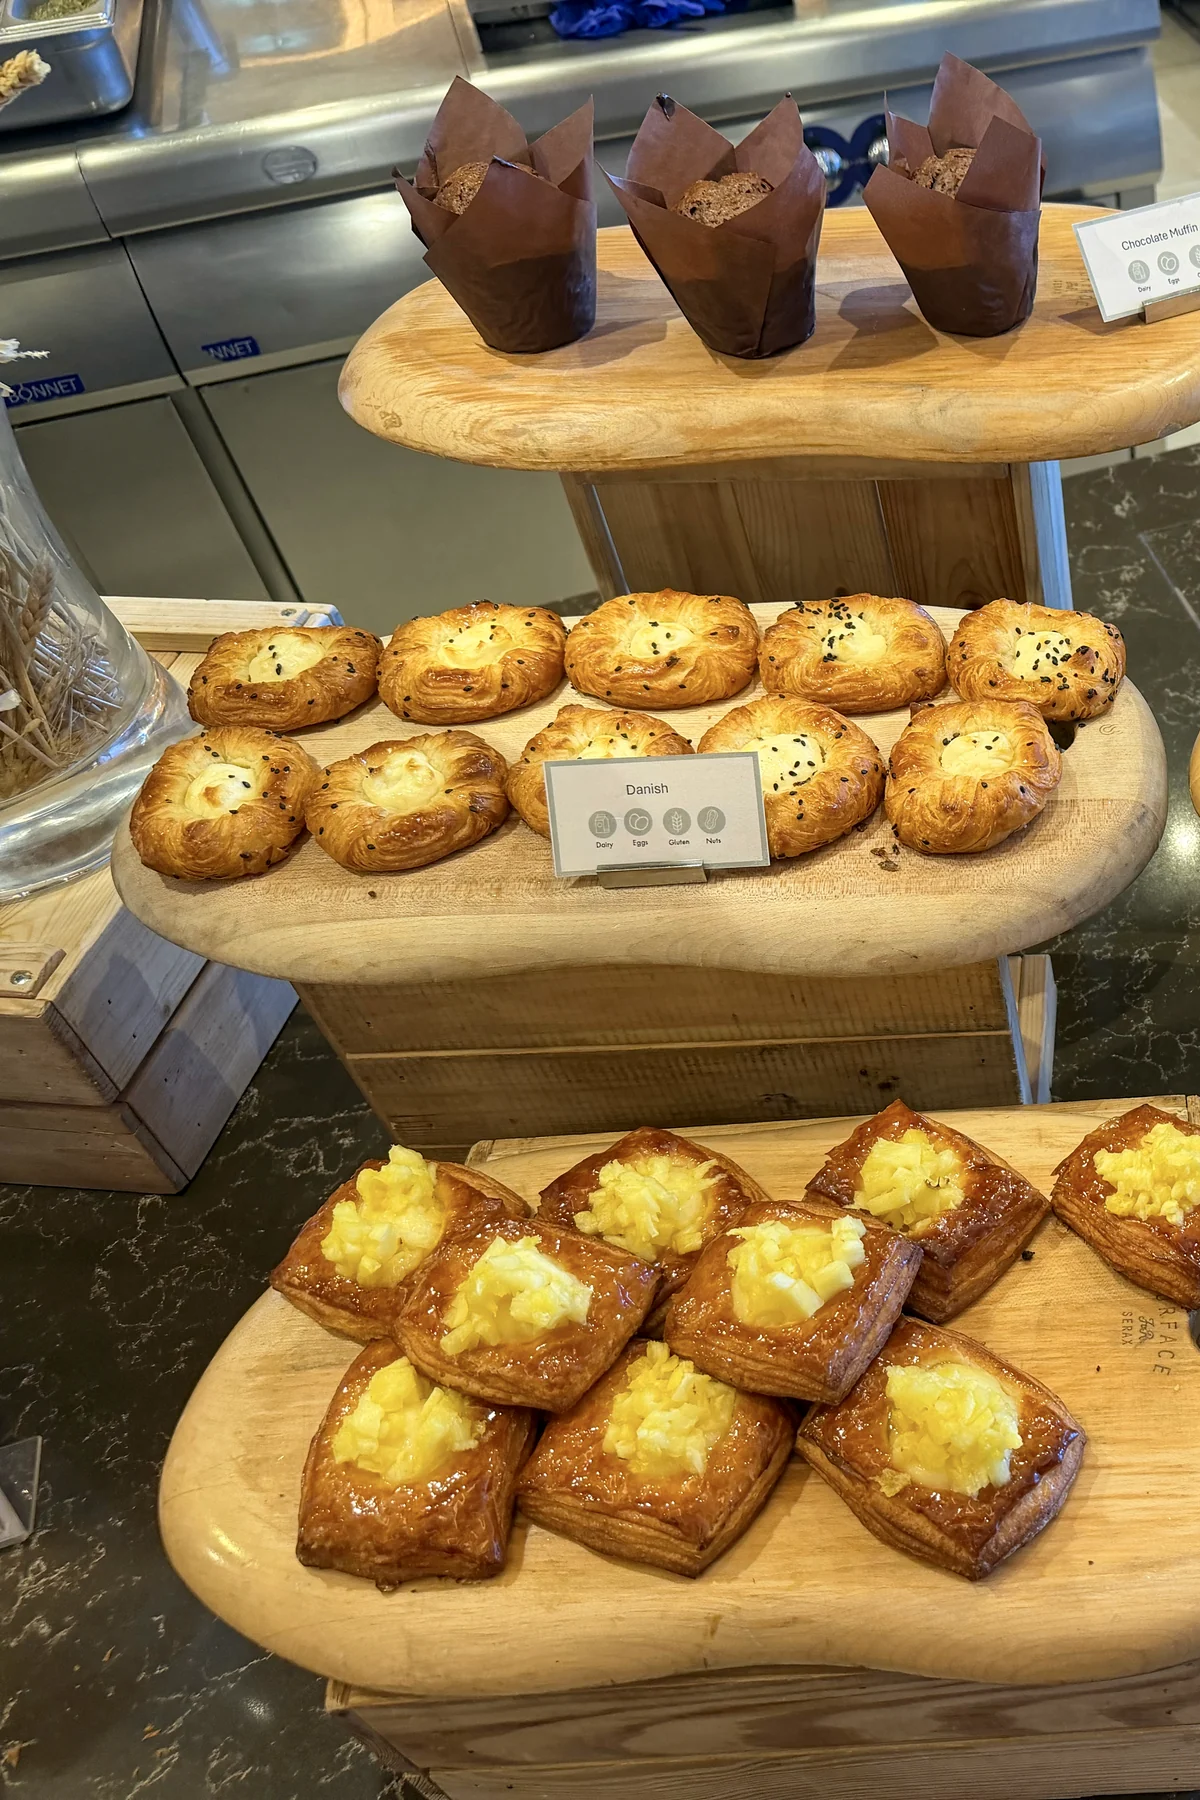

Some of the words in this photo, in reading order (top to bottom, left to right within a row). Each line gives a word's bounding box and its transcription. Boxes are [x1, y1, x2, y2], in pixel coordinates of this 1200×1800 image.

[1121, 233, 1168, 251] Chocolate
[1169, 223, 1199, 239] Muffin
[1138, 285, 1152, 293] Dairy
[1168, 277, 1180, 285] Eggs
[9, 378, 77, 403] BONNET
[626, 783, 669, 796] Danish
[596, 841, 614, 849] Dairy
[632, 838, 649, 847] Eggs
[668, 838, 690, 846] Gluten
[1122, 1312, 1133, 1345] SERAX
